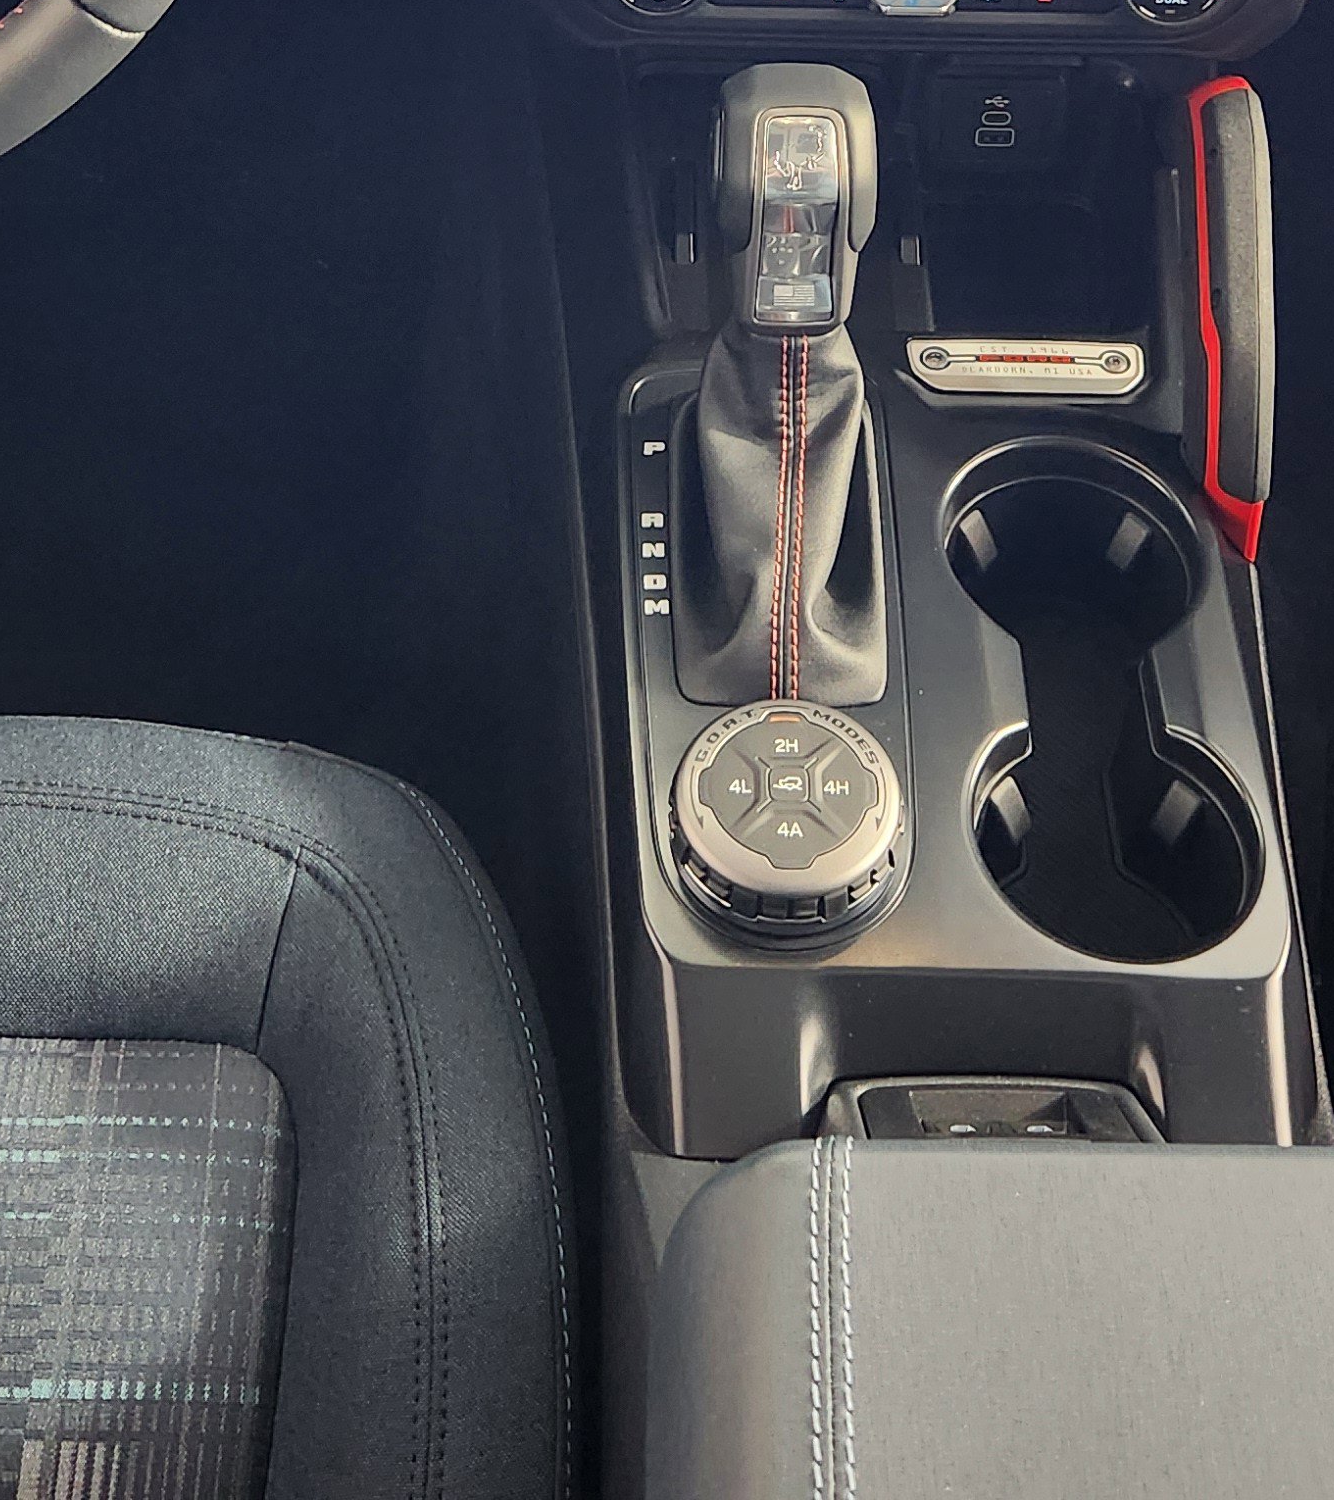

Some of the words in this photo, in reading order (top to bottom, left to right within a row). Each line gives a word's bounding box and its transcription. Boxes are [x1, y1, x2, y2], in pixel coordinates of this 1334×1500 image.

[642, 441, 666, 456] P
[642, 542, 666, 558] N
[643, 574, 667, 590] D
[644, 599, 670, 616] M
[812, 709, 881, 765] MODES
[774, 738, 799, 753] 2H
[728, 779, 753, 794] 4L
[823, 780, 849, 796] 4H
[777, 822, 804, 838] 4A
